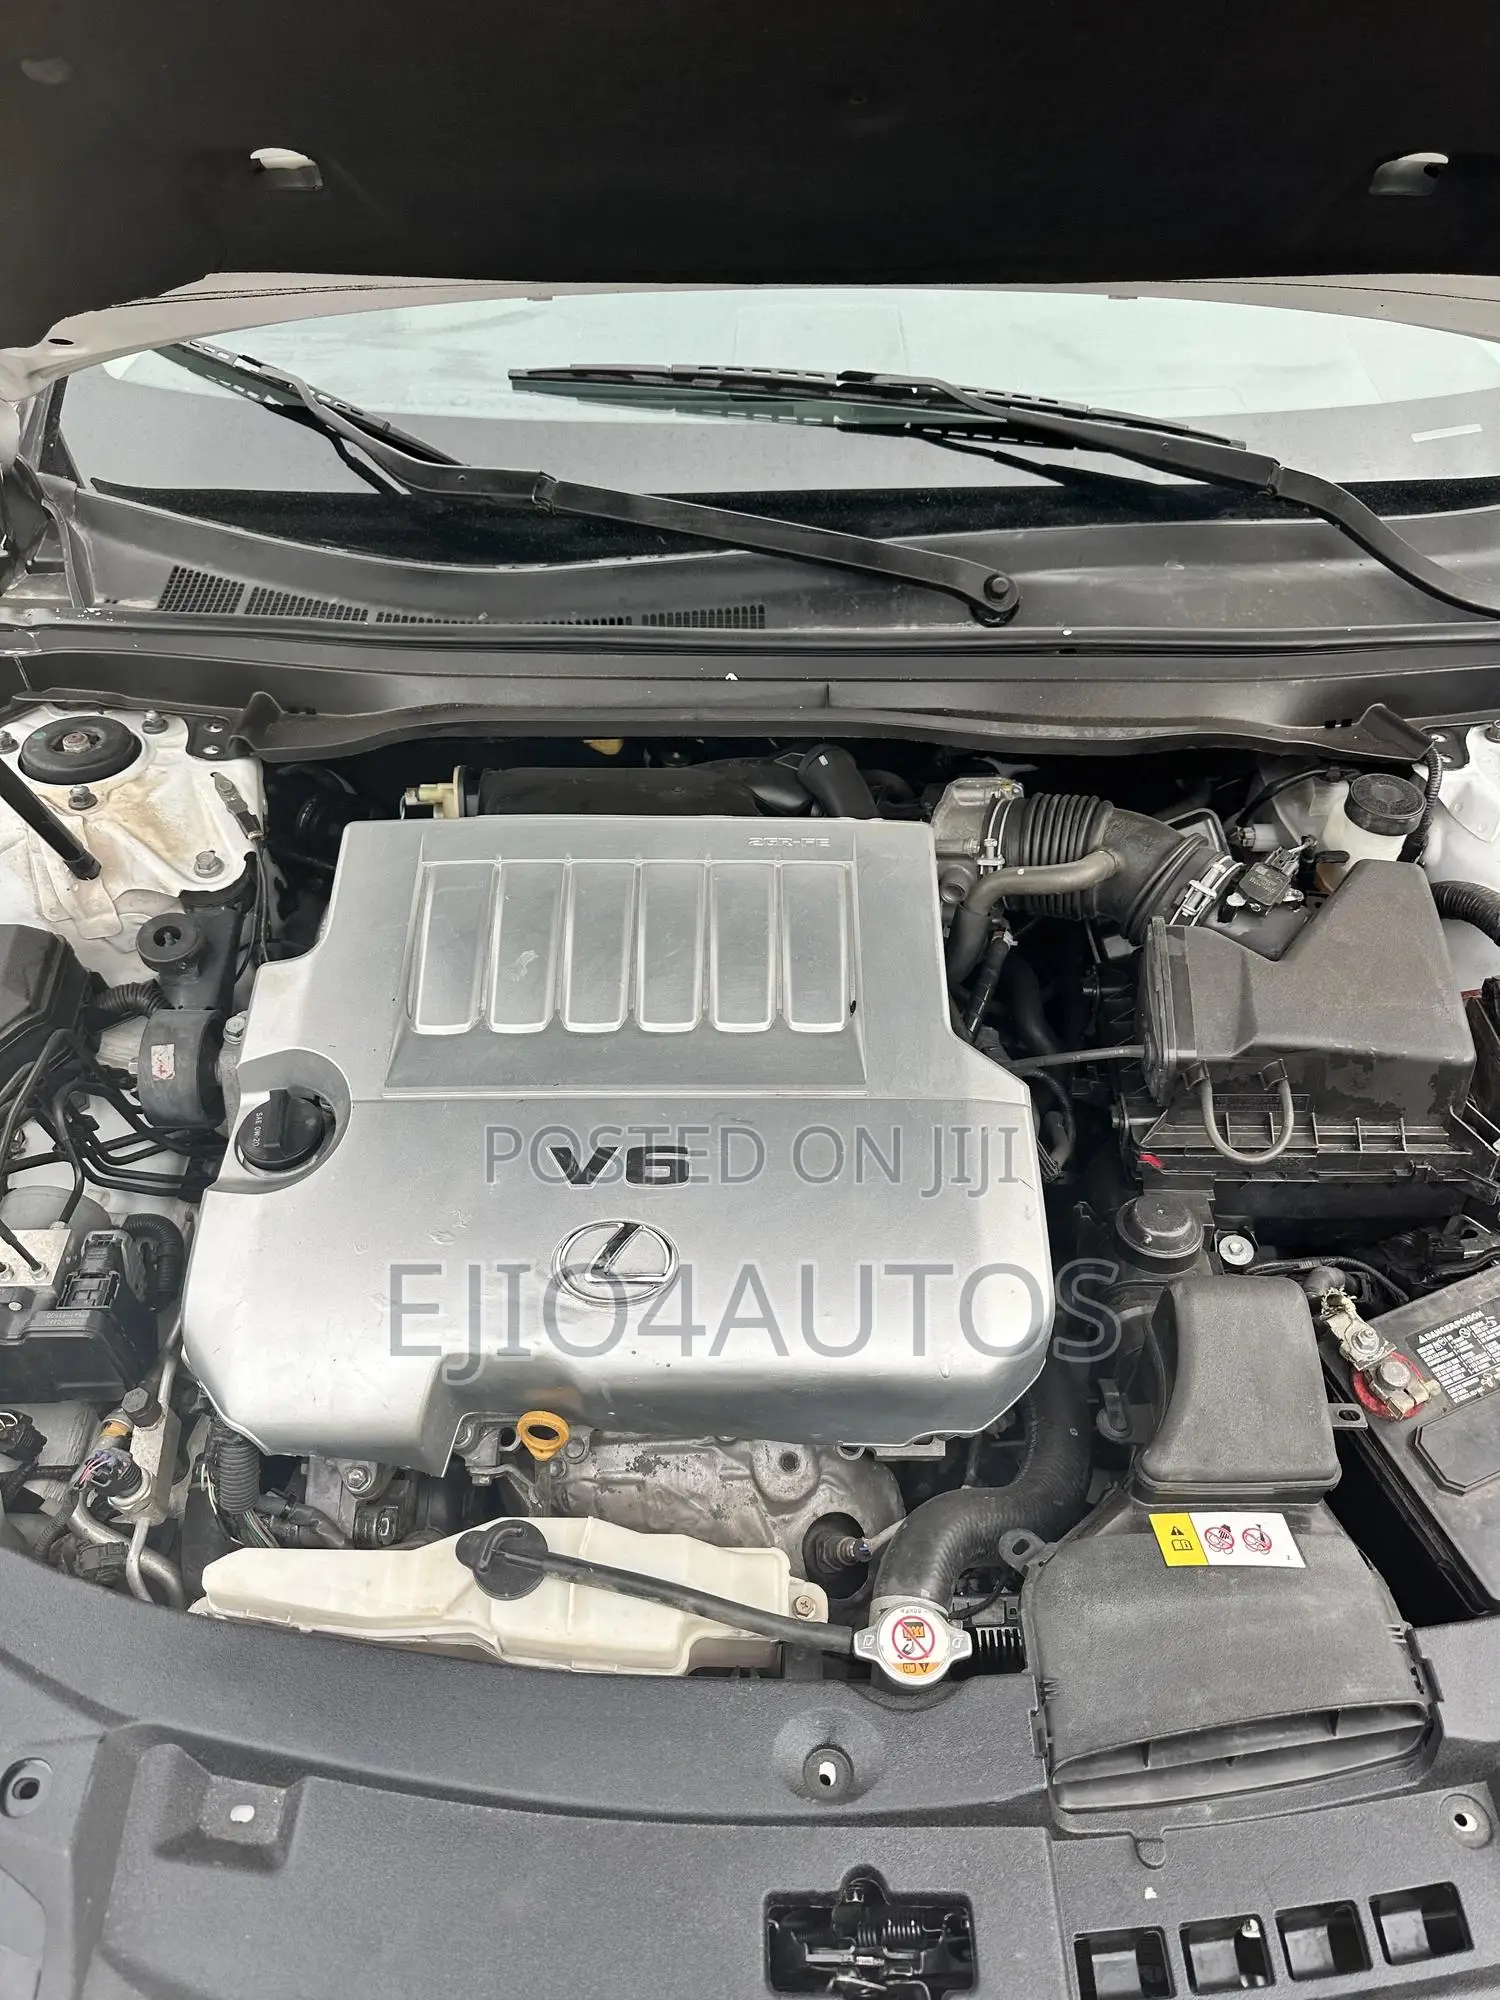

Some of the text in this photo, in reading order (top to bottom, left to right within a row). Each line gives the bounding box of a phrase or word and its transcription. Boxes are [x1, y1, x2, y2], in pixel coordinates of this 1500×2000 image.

[749, 837, 831, 847] 2GR-FE
[255, 1111, 263, 1124] SAE
[547, 1144, 692, 1189] V6
